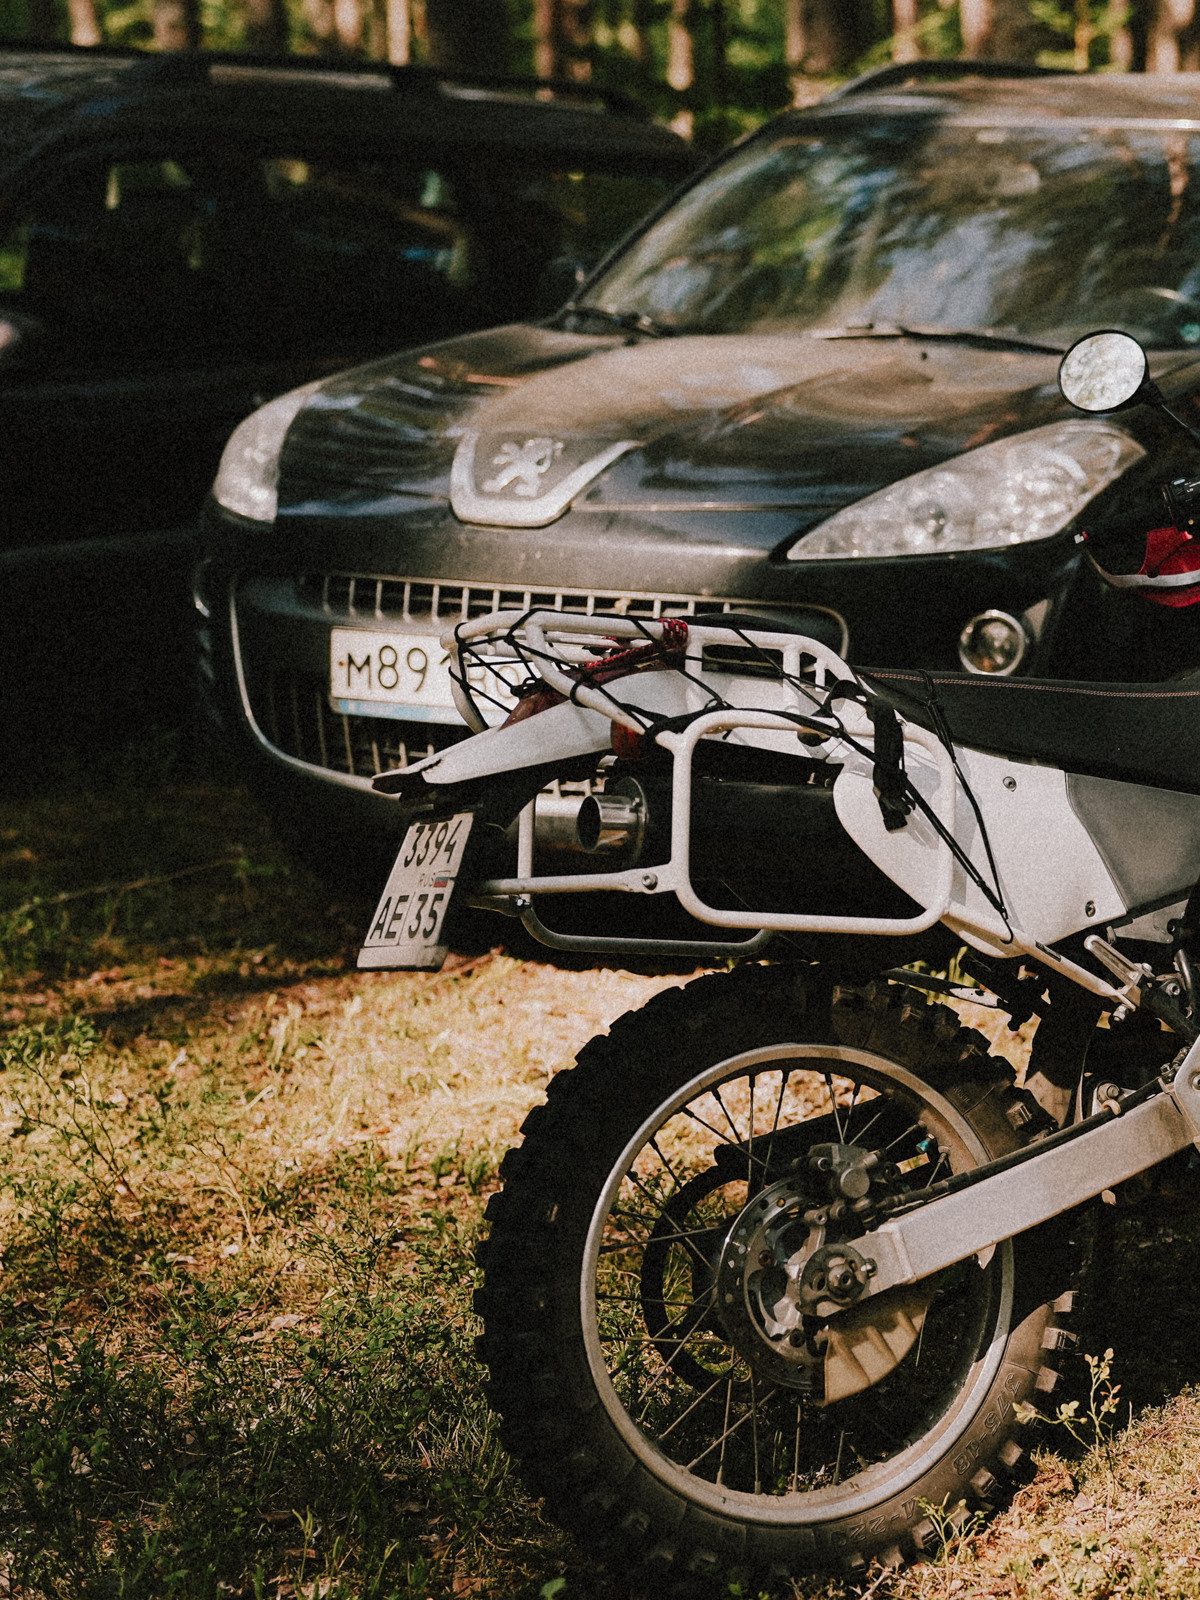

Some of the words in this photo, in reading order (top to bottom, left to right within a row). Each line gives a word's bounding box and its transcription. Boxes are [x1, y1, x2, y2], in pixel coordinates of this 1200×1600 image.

[404, 820, 463, 868] 3394
[418, 872, 436, 888] RUS
[408, 893, 445, 939] 35
